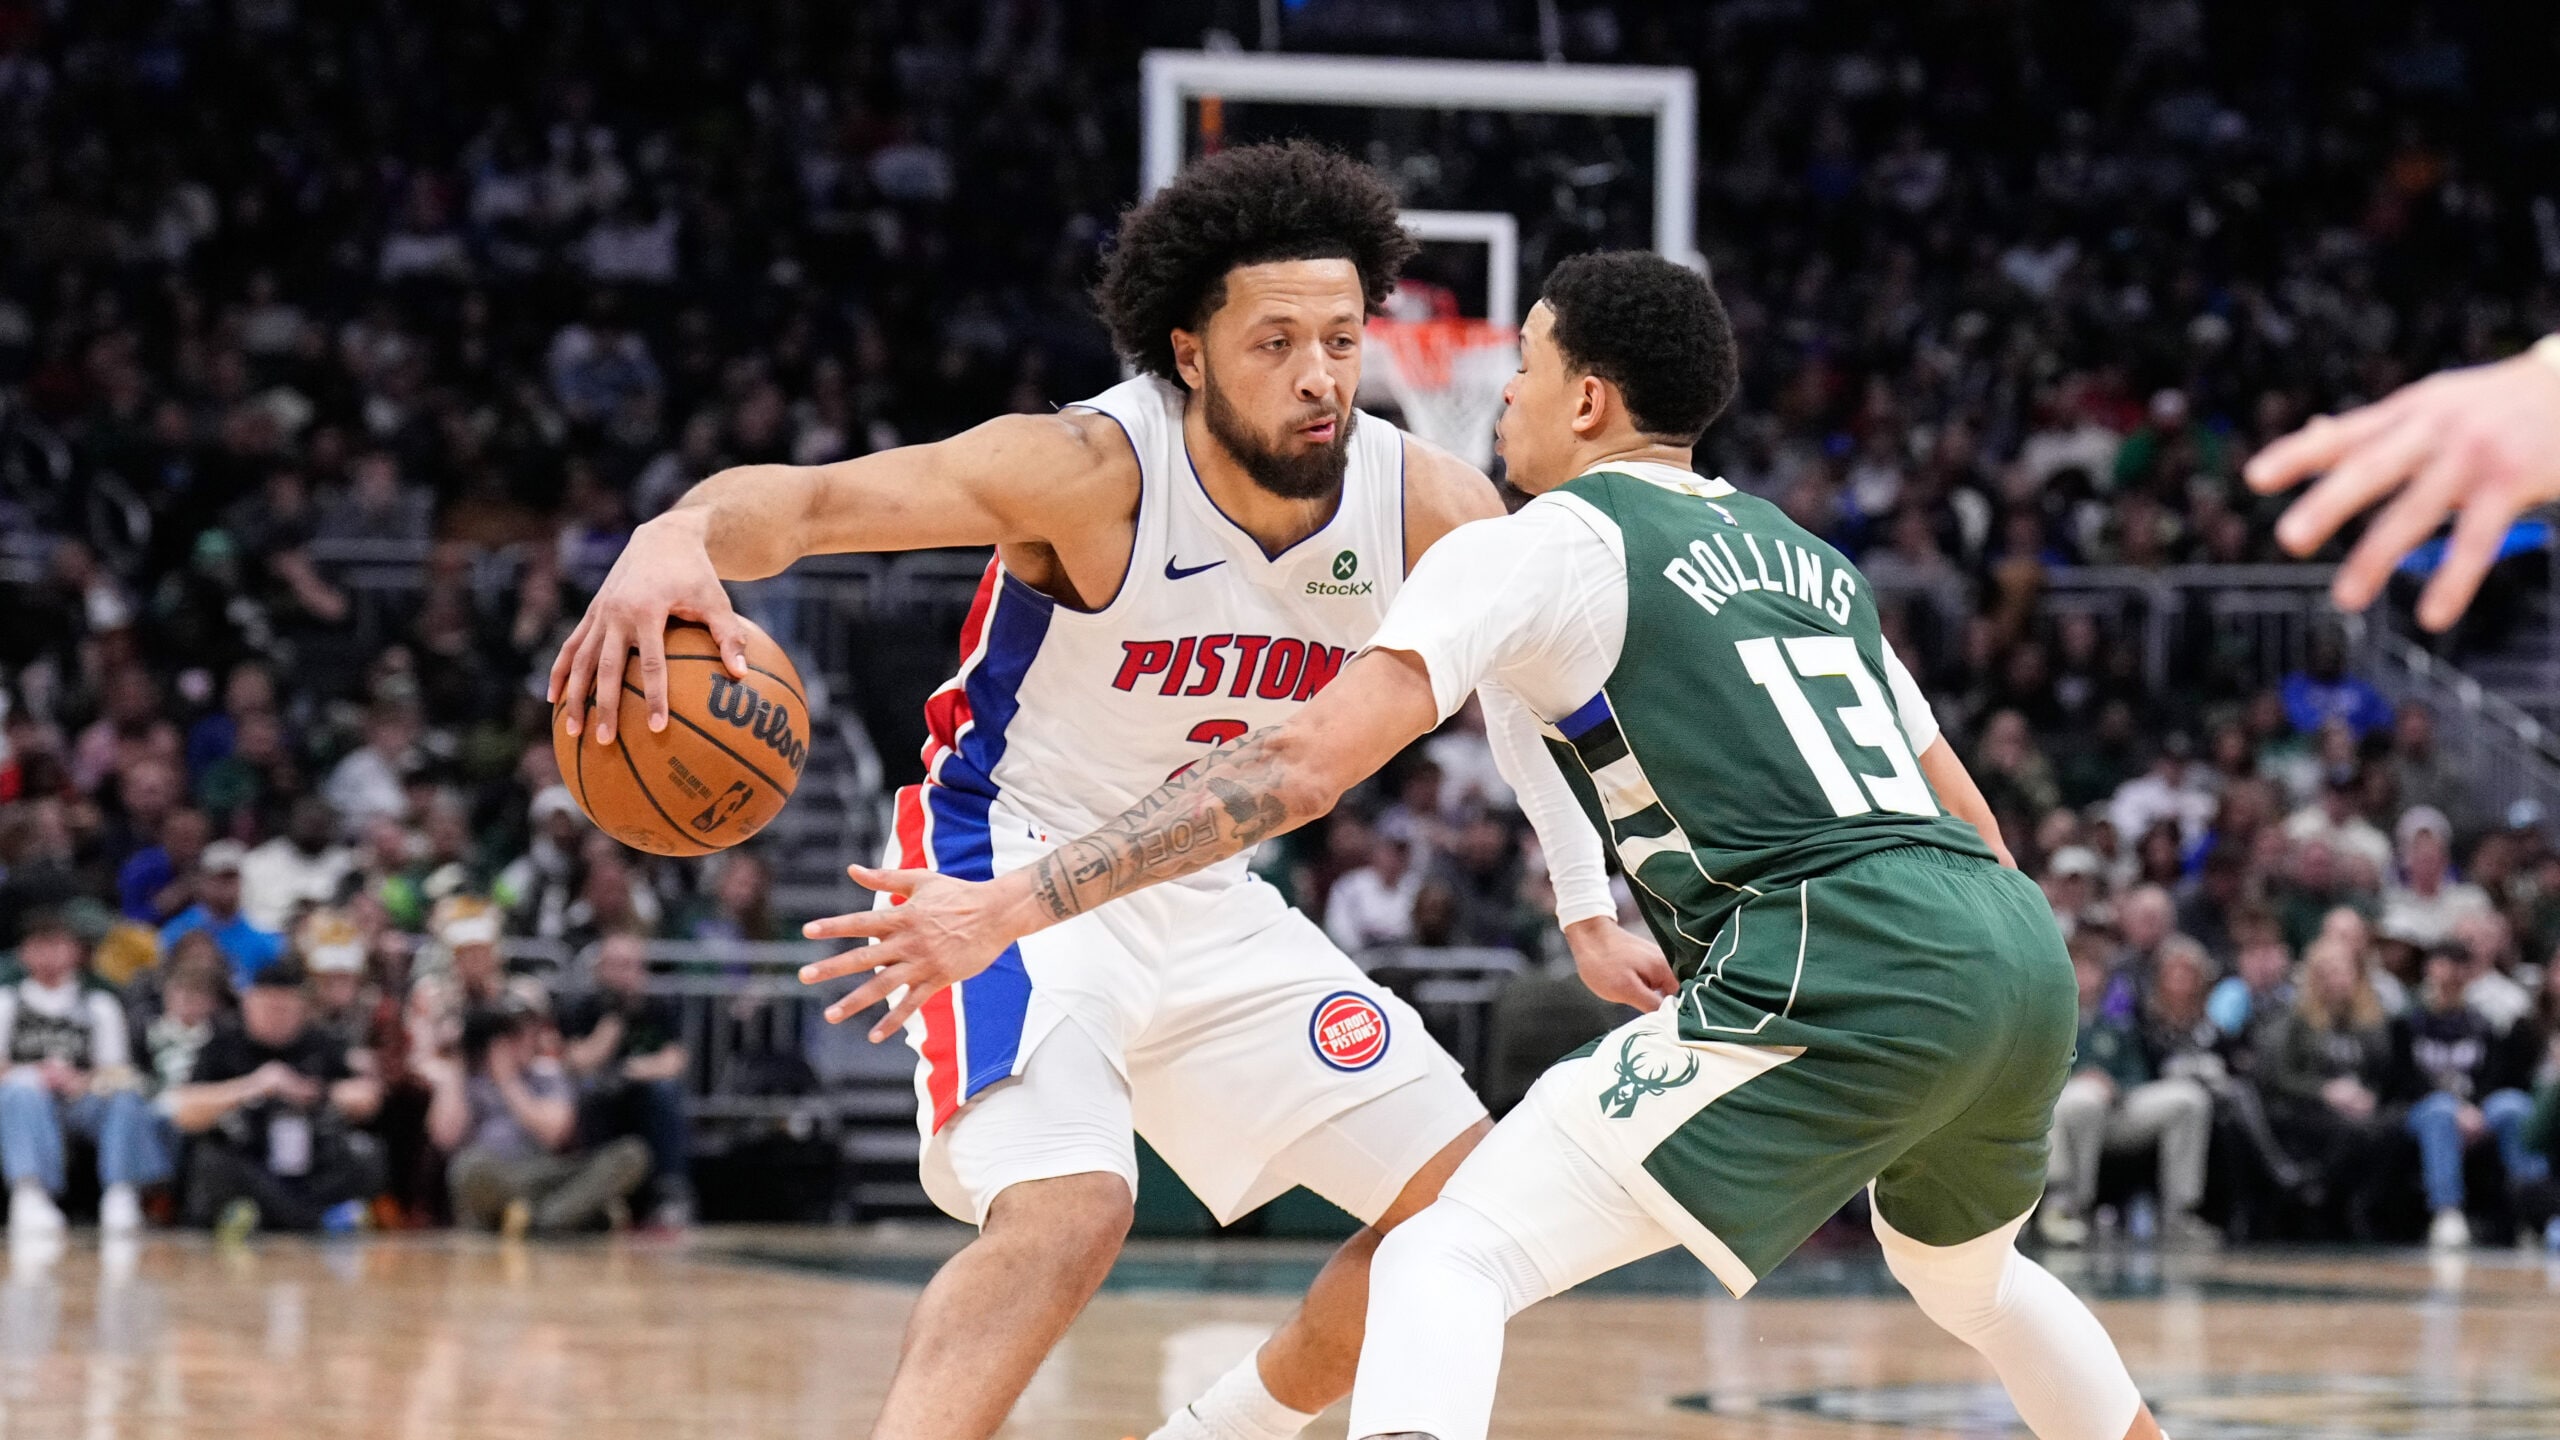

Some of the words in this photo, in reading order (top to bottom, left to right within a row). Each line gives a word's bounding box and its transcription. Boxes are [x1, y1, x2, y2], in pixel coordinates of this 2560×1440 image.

[1305, 581, 1373, 596] StockX
[1663, 533, 1856, 625] ROLLINS
[1112, 633, 1357, 702] PISTON
[1734, 636, 1940, 817] 13
[1323, 1010, 1371, 1040] DETROIT
[1328, 1023, 1378, 1053] PISTONS
